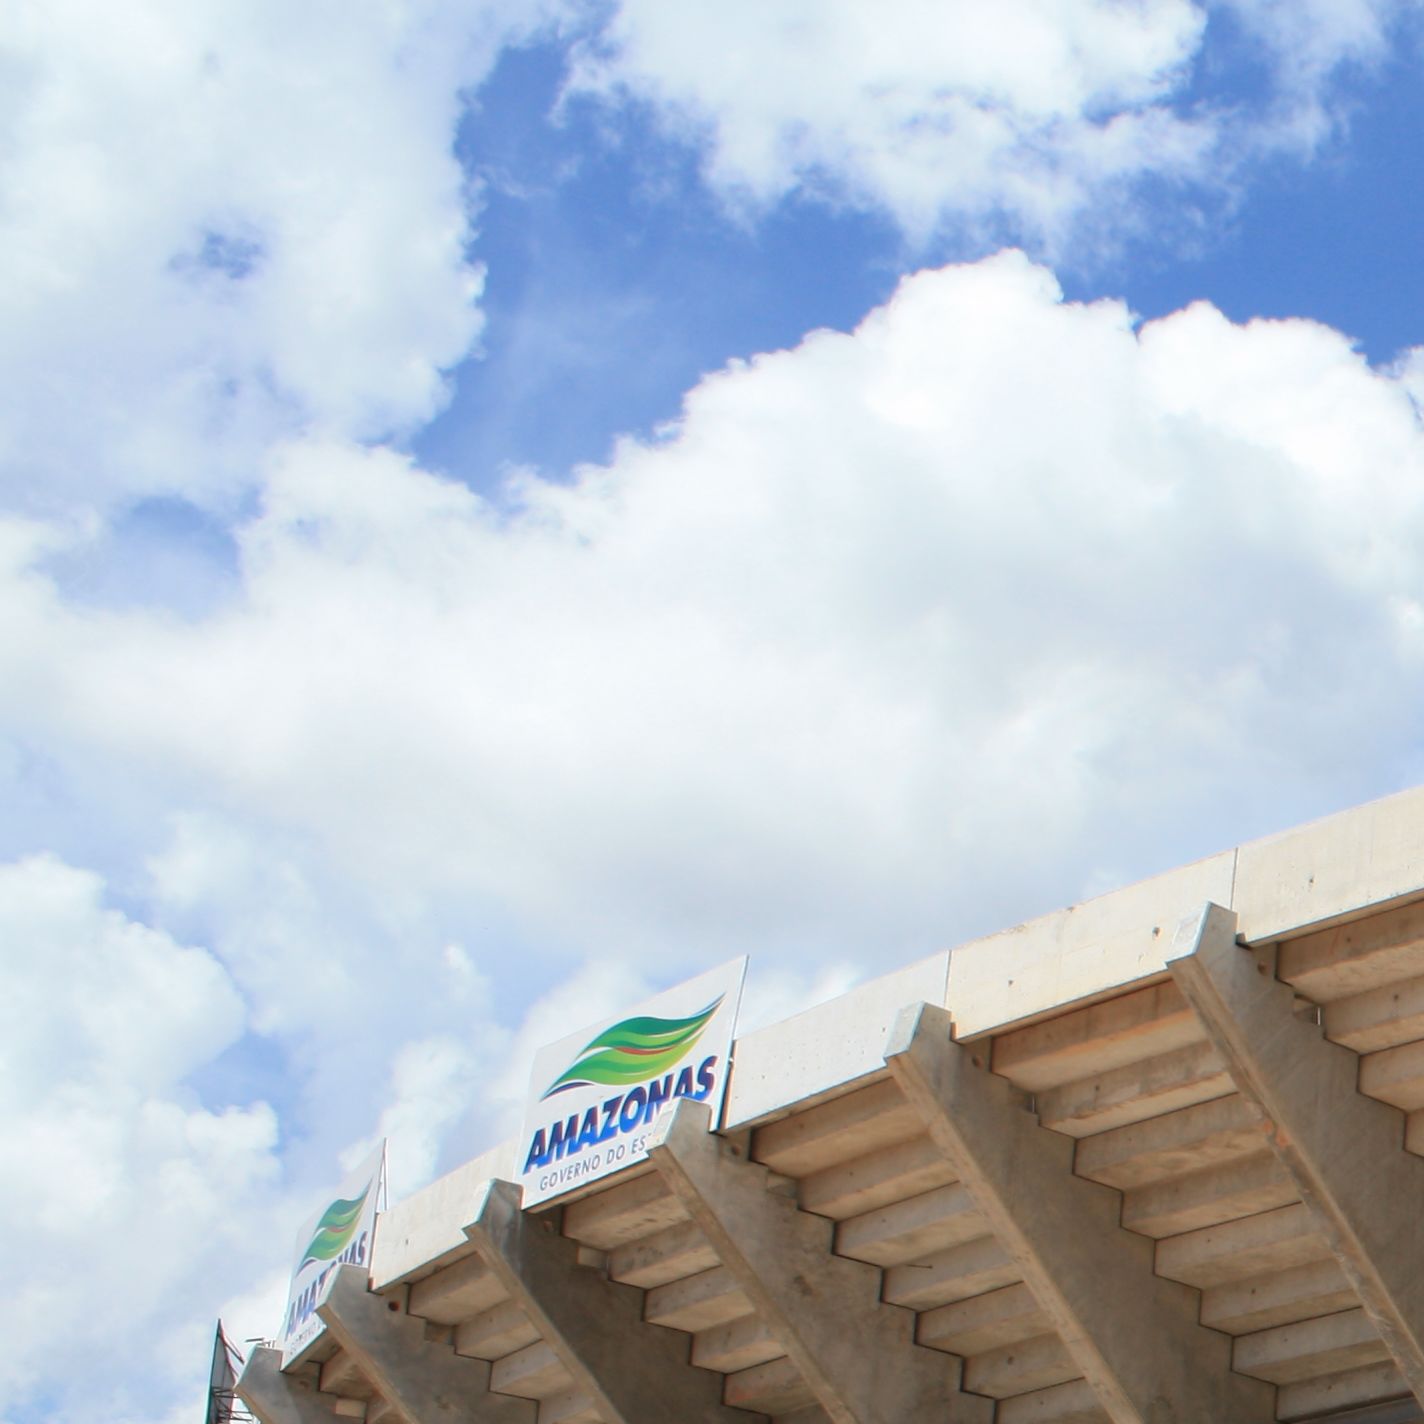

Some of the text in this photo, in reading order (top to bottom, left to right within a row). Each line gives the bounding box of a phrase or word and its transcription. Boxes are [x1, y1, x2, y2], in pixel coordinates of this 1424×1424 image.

[522, 1055, 718, 1176] AMAZONAS
[539, 1154, 601, 1192] GOVERNO
[606, 1144, 626, 1166] DO
